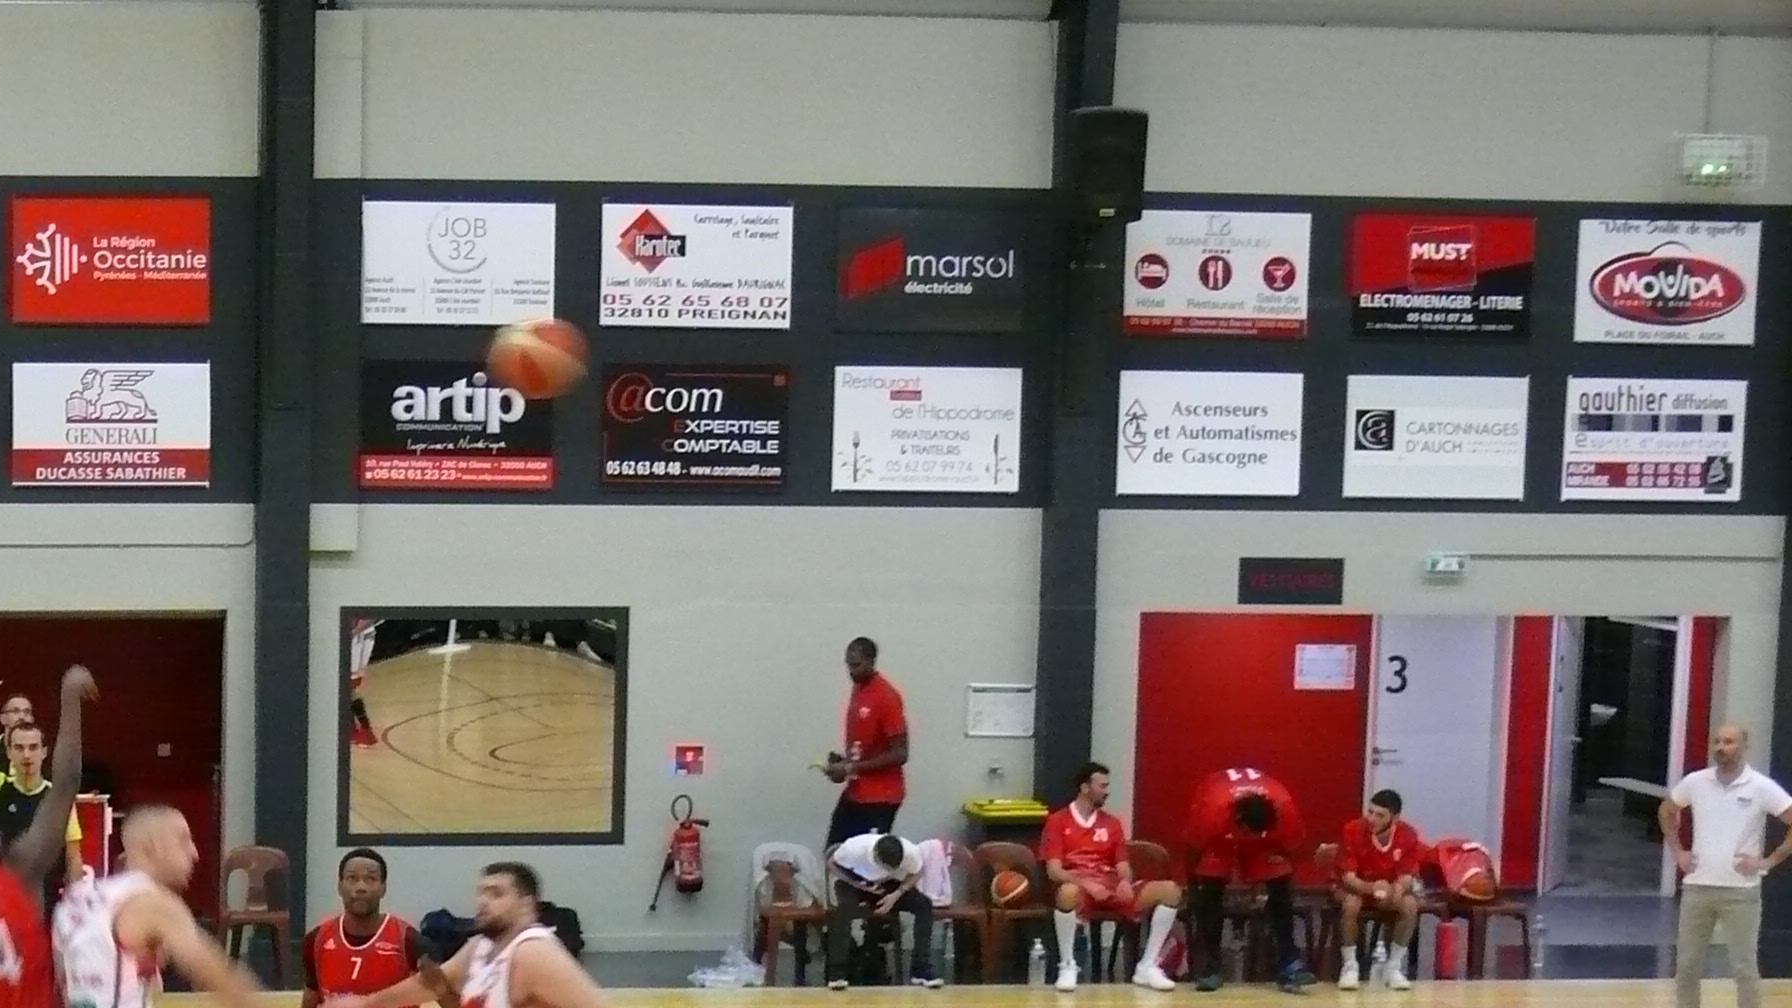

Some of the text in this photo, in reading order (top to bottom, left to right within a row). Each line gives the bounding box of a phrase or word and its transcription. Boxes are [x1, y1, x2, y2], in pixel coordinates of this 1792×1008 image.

[438, 217, 487, 238] JOB
[93, 235, 155, 250] La Région
[448, 240, 476, 260] 32
[93, 249, 207, 269] Occitanie
[1411, 243, 1472, 261] MUST
[906, 249, 1014, 279] marsol
[904, 281, 973, 295] électricité
[1613, 264, 1725, 300] MOVIDA
[603, 294, 788, 308] 05 62 65 68 07
[1360, 294, 1523, 310] ELECTROMENAGER LITERIE
[604, 307, 787, 320] 32810 PREIGNAN
[842, 372, 921, 389] Restaurant
[391, 371, 526, 434] artip
[607, 372, 723, 422] @com
[1579, 385, 1728, 415] gauthier diffusion
[893, 405, 913, 419] de
[1171, 401, 1268, 417] Ascenseurs
[396, 423, 484, 431] COMMUNICATION
[674, 419, 780, 434] EXPERTISE
[1154, 425, 1297, 441] et Automatismes
[1406, 421, 1520, 436] CARTONNAGES
[66, 427, 158, 445] GENERALI
[891, 429, 970, 441] PRIVATISATIONS
[662, 438, 779, 454] COMPTABLE
[911, 445, 960, 455] TRAITEURS
[1406, 440, 1462, 453] D'AUCH
[63, 451, 159, 464] ASSURANCES
[1153, 448, 1268, 468] de Gascogne
[36, 467, 186, 480] DUCASSE SABATHIER
[374, 469, 456, 480] 05 62 61 23 23
[606, 461, 681, 476] 05 62 63 48 48
[886, 461, 973, 472] 05 62 07 99 74
[1386, 655, 1407, 693] 3
[351, 956, 363, 980] 7
